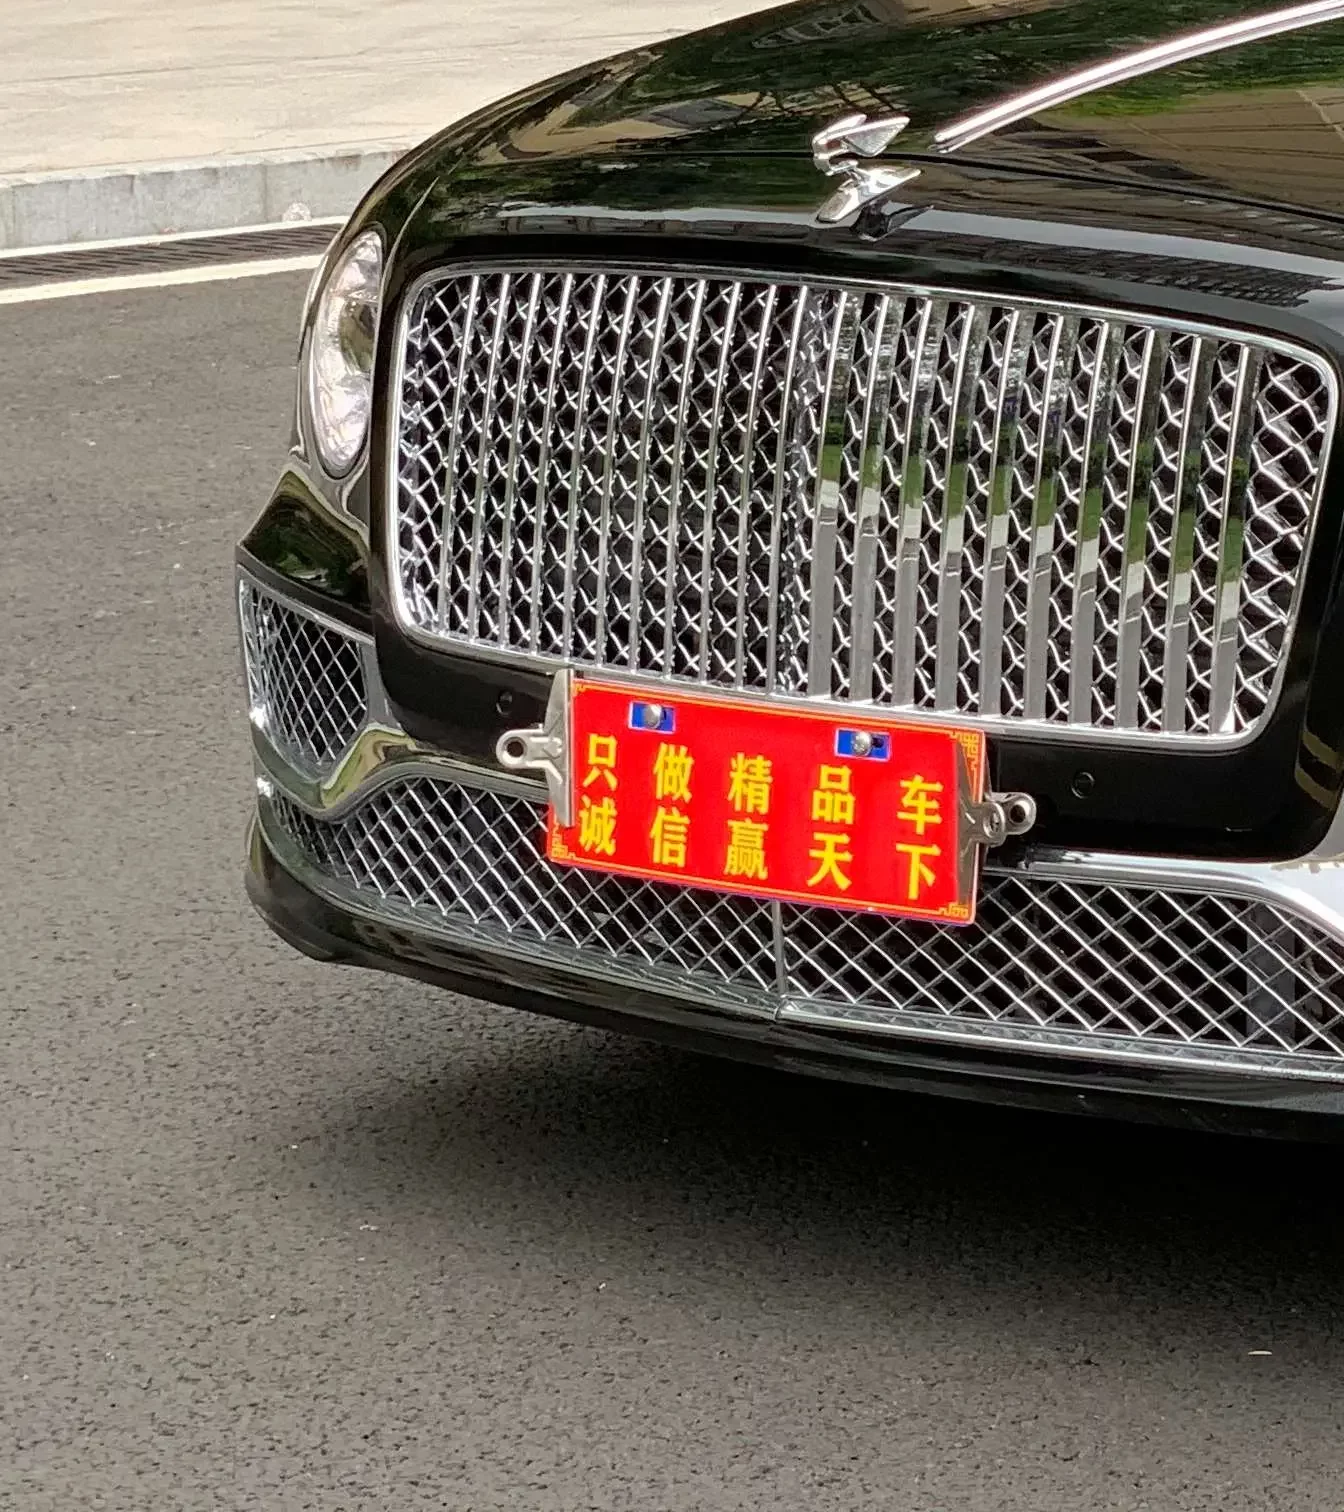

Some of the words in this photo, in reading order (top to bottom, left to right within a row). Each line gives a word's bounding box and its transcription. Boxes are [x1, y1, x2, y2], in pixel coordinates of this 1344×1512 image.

[582, 733, 943, 835] 只做精品车
[578, 795, 942, 900] 诚信赢天下
